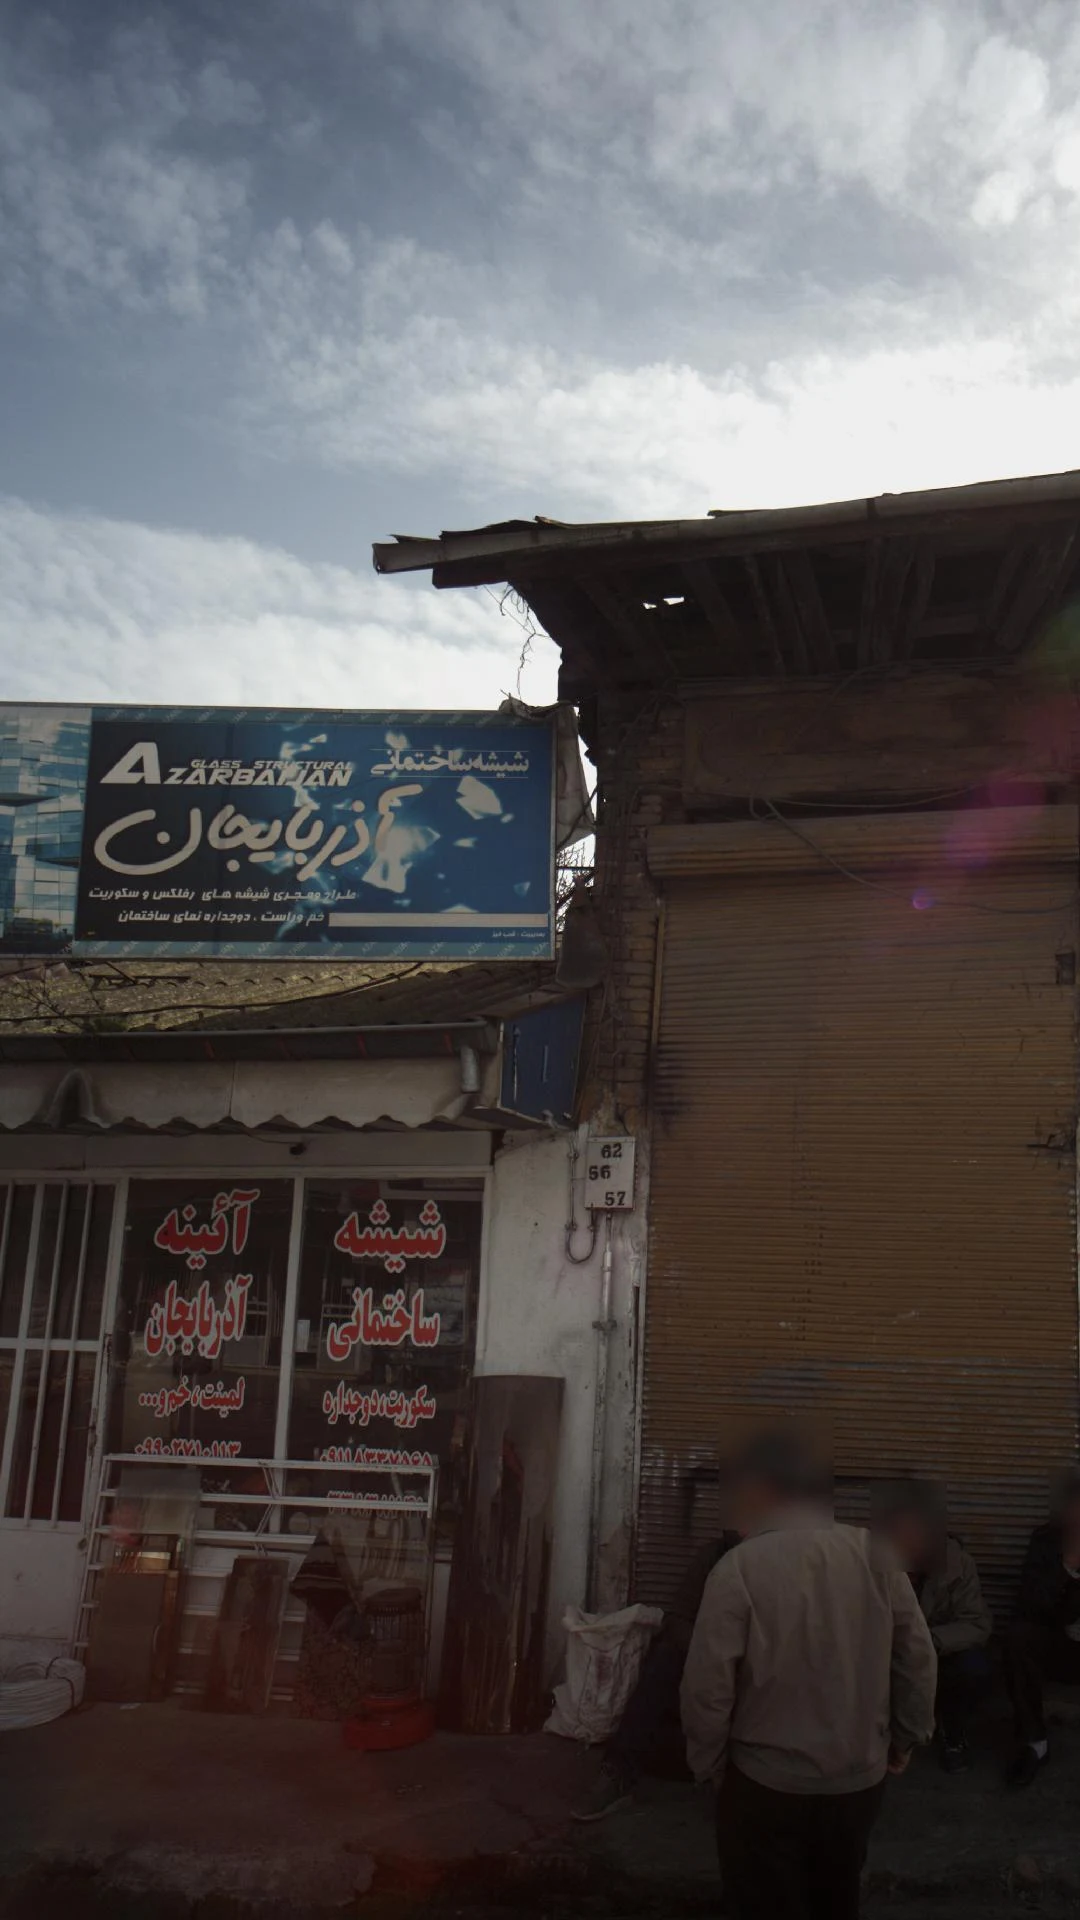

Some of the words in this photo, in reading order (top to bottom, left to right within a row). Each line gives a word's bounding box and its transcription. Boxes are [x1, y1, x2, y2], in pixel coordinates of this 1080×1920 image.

[191, 759, 242, 769] GLASS
[254, 760, 353, 770] STRUCTURAL
[370, 749, 472, 776] ساختمانی
[473, 752, 529, 779] شیشه
[94, 784, 424, 882] آذربایجان
[88, 887, 140, 902] سکوریت
[142, 890, 149, 901] و
[152, 887, 196, 901] رفلکس
[201, 888, 231, 901] های
[235, 886, 270, 902] شیشه
[321, 889, 357, 904] طراح
[118, 910, 170, 923] ساختمان
[173, 910, 201, 923] نمای
[305, 911, 325, 926] خم
[601, 1142, 622, 1159] 62
[589, 1165, 611, 1180] 56
[605, 1191, 626, 1206] 57
[154, 1189, 260, 1269] آئینه
[333, 1199, 446, 1273] شیشه
[144, 1273, 253, 1358] آذربایجان
[326, 1287, 440, 1362] ساختمانی
